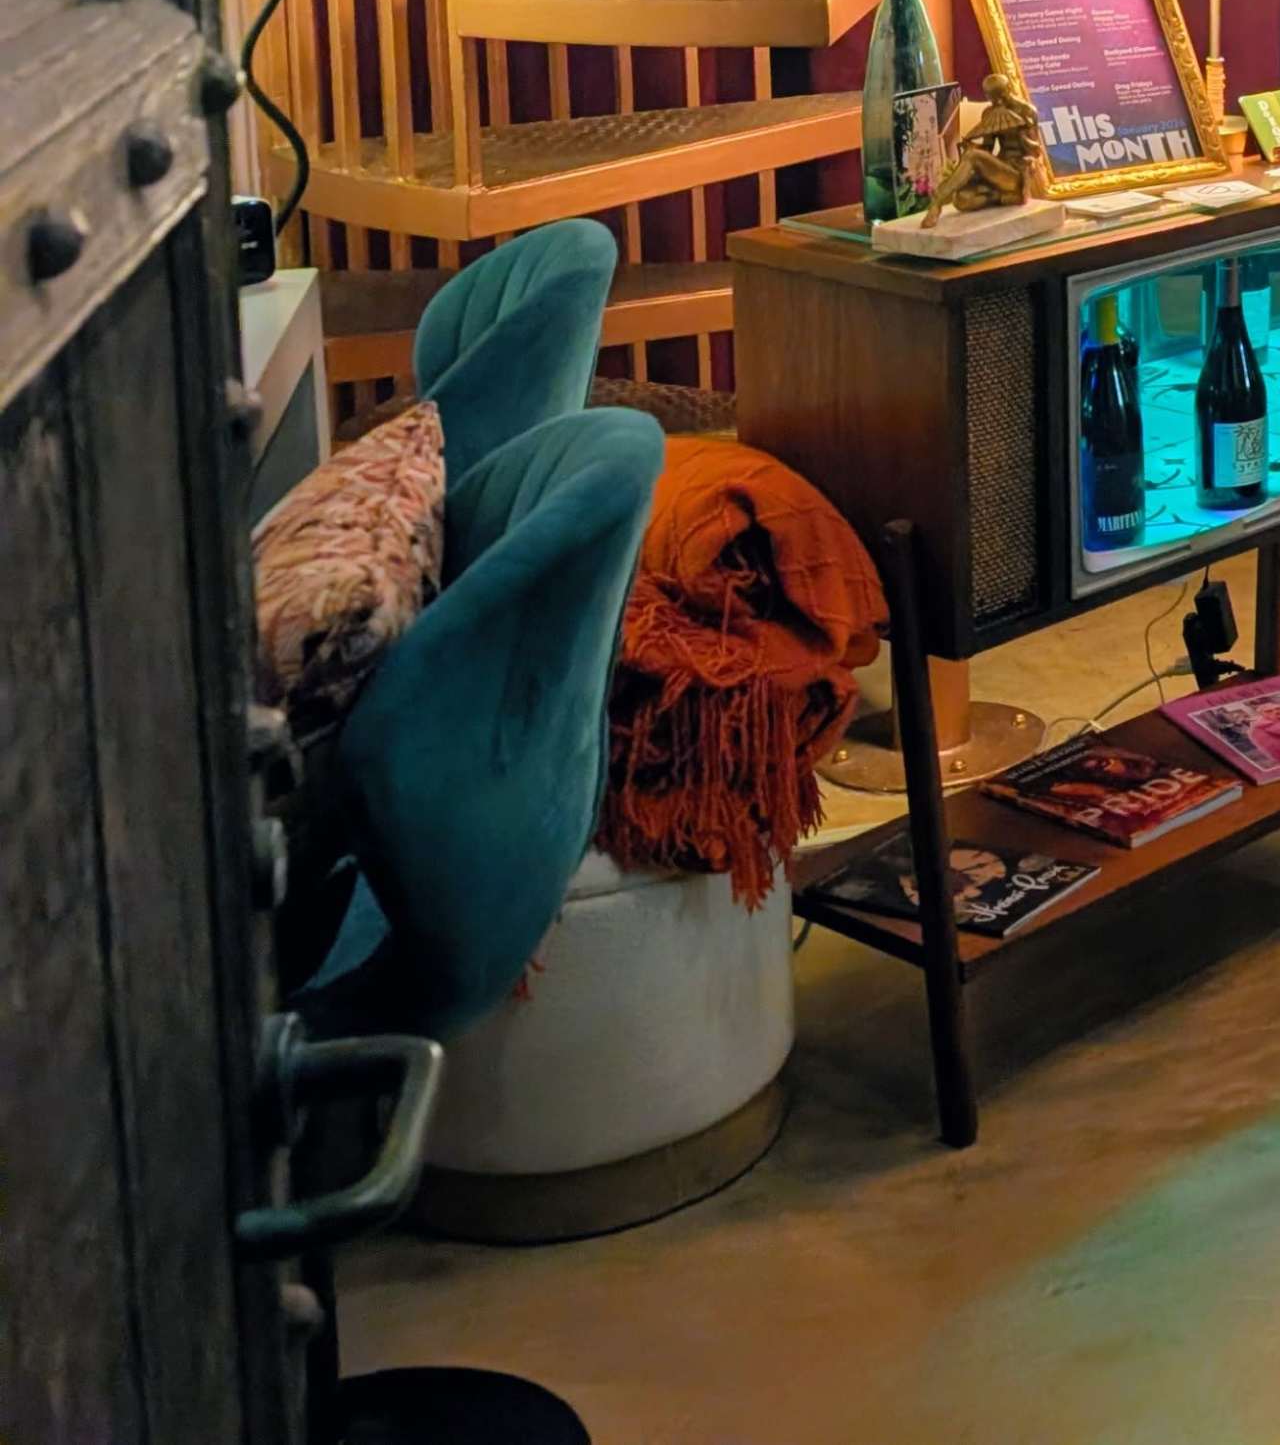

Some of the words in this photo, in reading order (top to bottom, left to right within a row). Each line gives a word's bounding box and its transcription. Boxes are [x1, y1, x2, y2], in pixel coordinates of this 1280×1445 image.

[1038, 105, 1115, 146] THIS
[1075, 129, 1195, 173] MONTH
[1075, 767, 1208, 824] PRIDE
